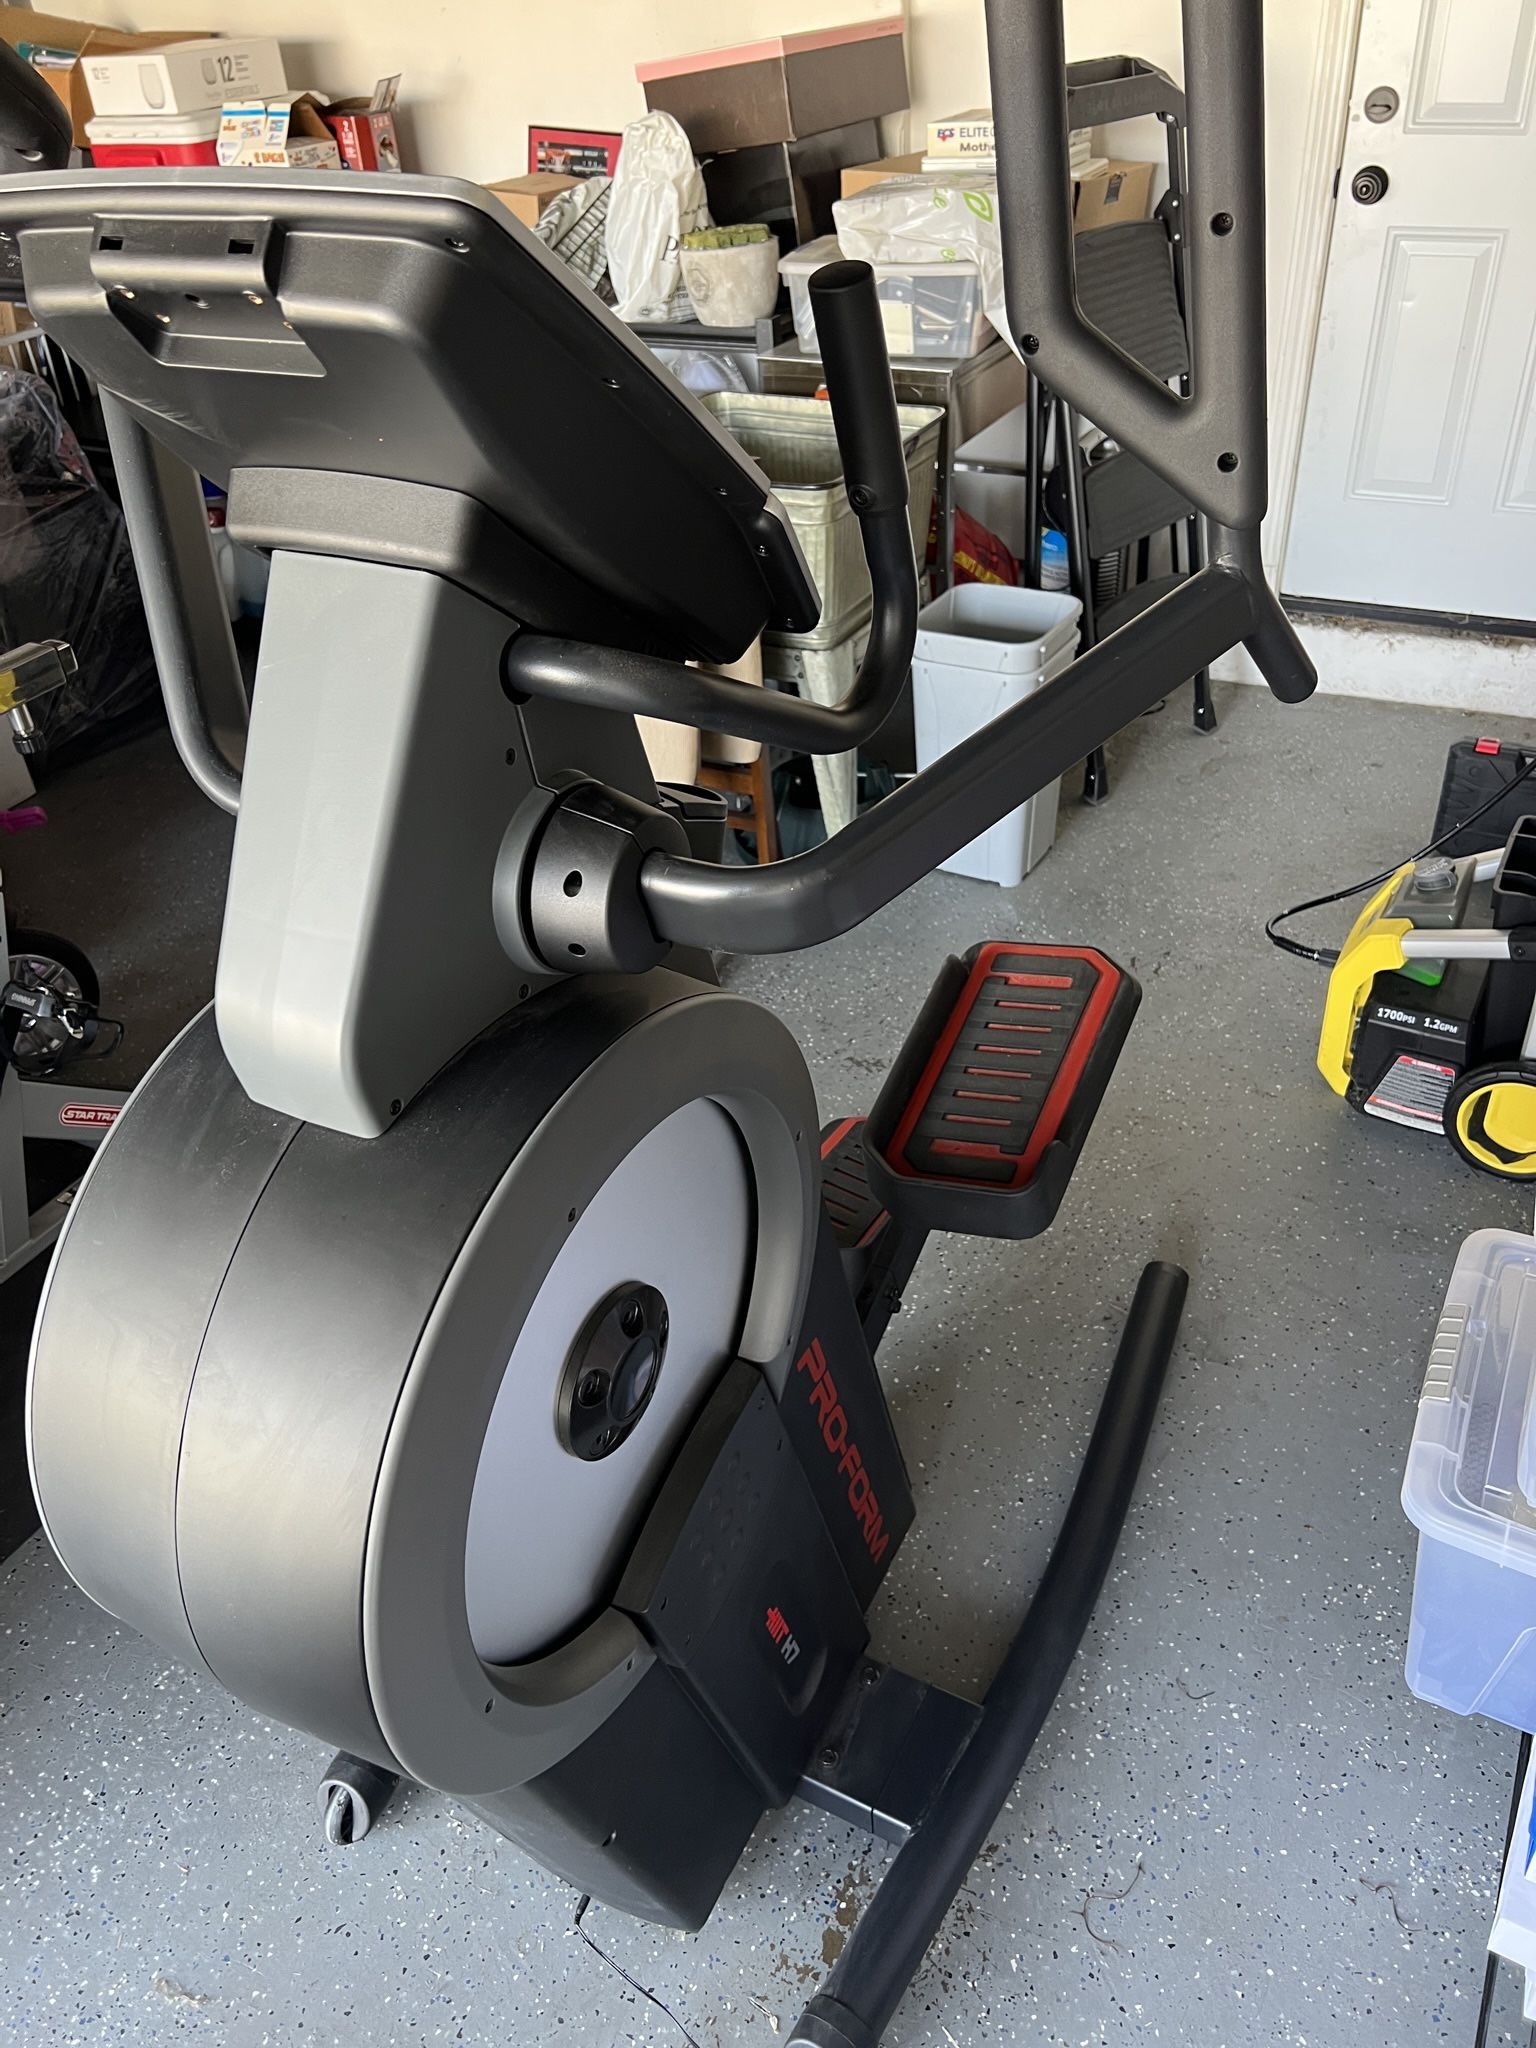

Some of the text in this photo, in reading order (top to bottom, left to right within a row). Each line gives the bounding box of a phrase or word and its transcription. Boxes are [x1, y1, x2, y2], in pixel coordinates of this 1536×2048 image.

[217, 56, 236, 82] 12
[64, 1110, 96, 1120] STAR
[796, 1337, 890, 1564] PRO-FORM
[780, 1633, 801, 1665] H7
